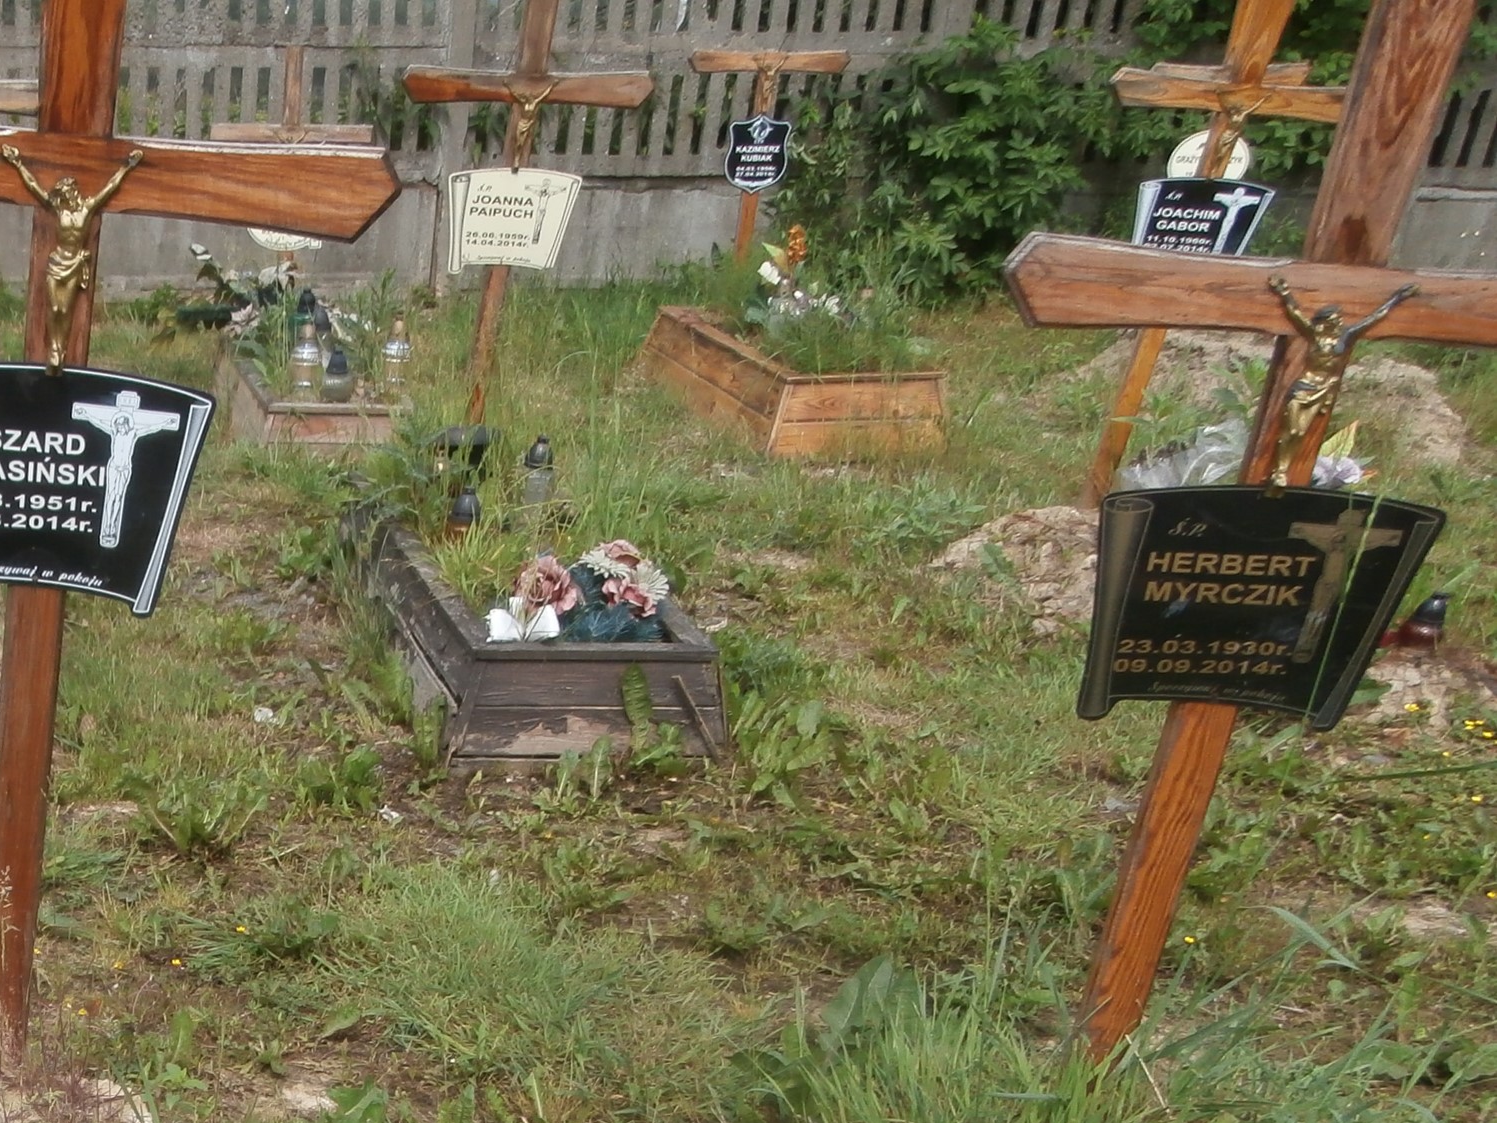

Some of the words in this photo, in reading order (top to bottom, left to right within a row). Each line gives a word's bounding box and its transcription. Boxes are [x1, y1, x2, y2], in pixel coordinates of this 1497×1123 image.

[740, 154, 773, 162] KUBIAK
[472, 195, 534, 206] JOANNA
[469, 207, 534, 219] PAIPUCH
[1153, 207, 1222, 220] JOACHIM
[1156, 220, 1211, 232] GABOR
[465, 239, 529, 248] 14.04.2014r.
[1146, 551, 1318, 577] HERBERT
[42, 569, 54, 578] w
[58, 572, 103, 587] pokoju
[1144, 581, 1303, 606] MYRCZIK
[1117, 639, 1292, 656] 23.03.1930r.
[1114, 659, 1287, 675] 09.09.2014r.
